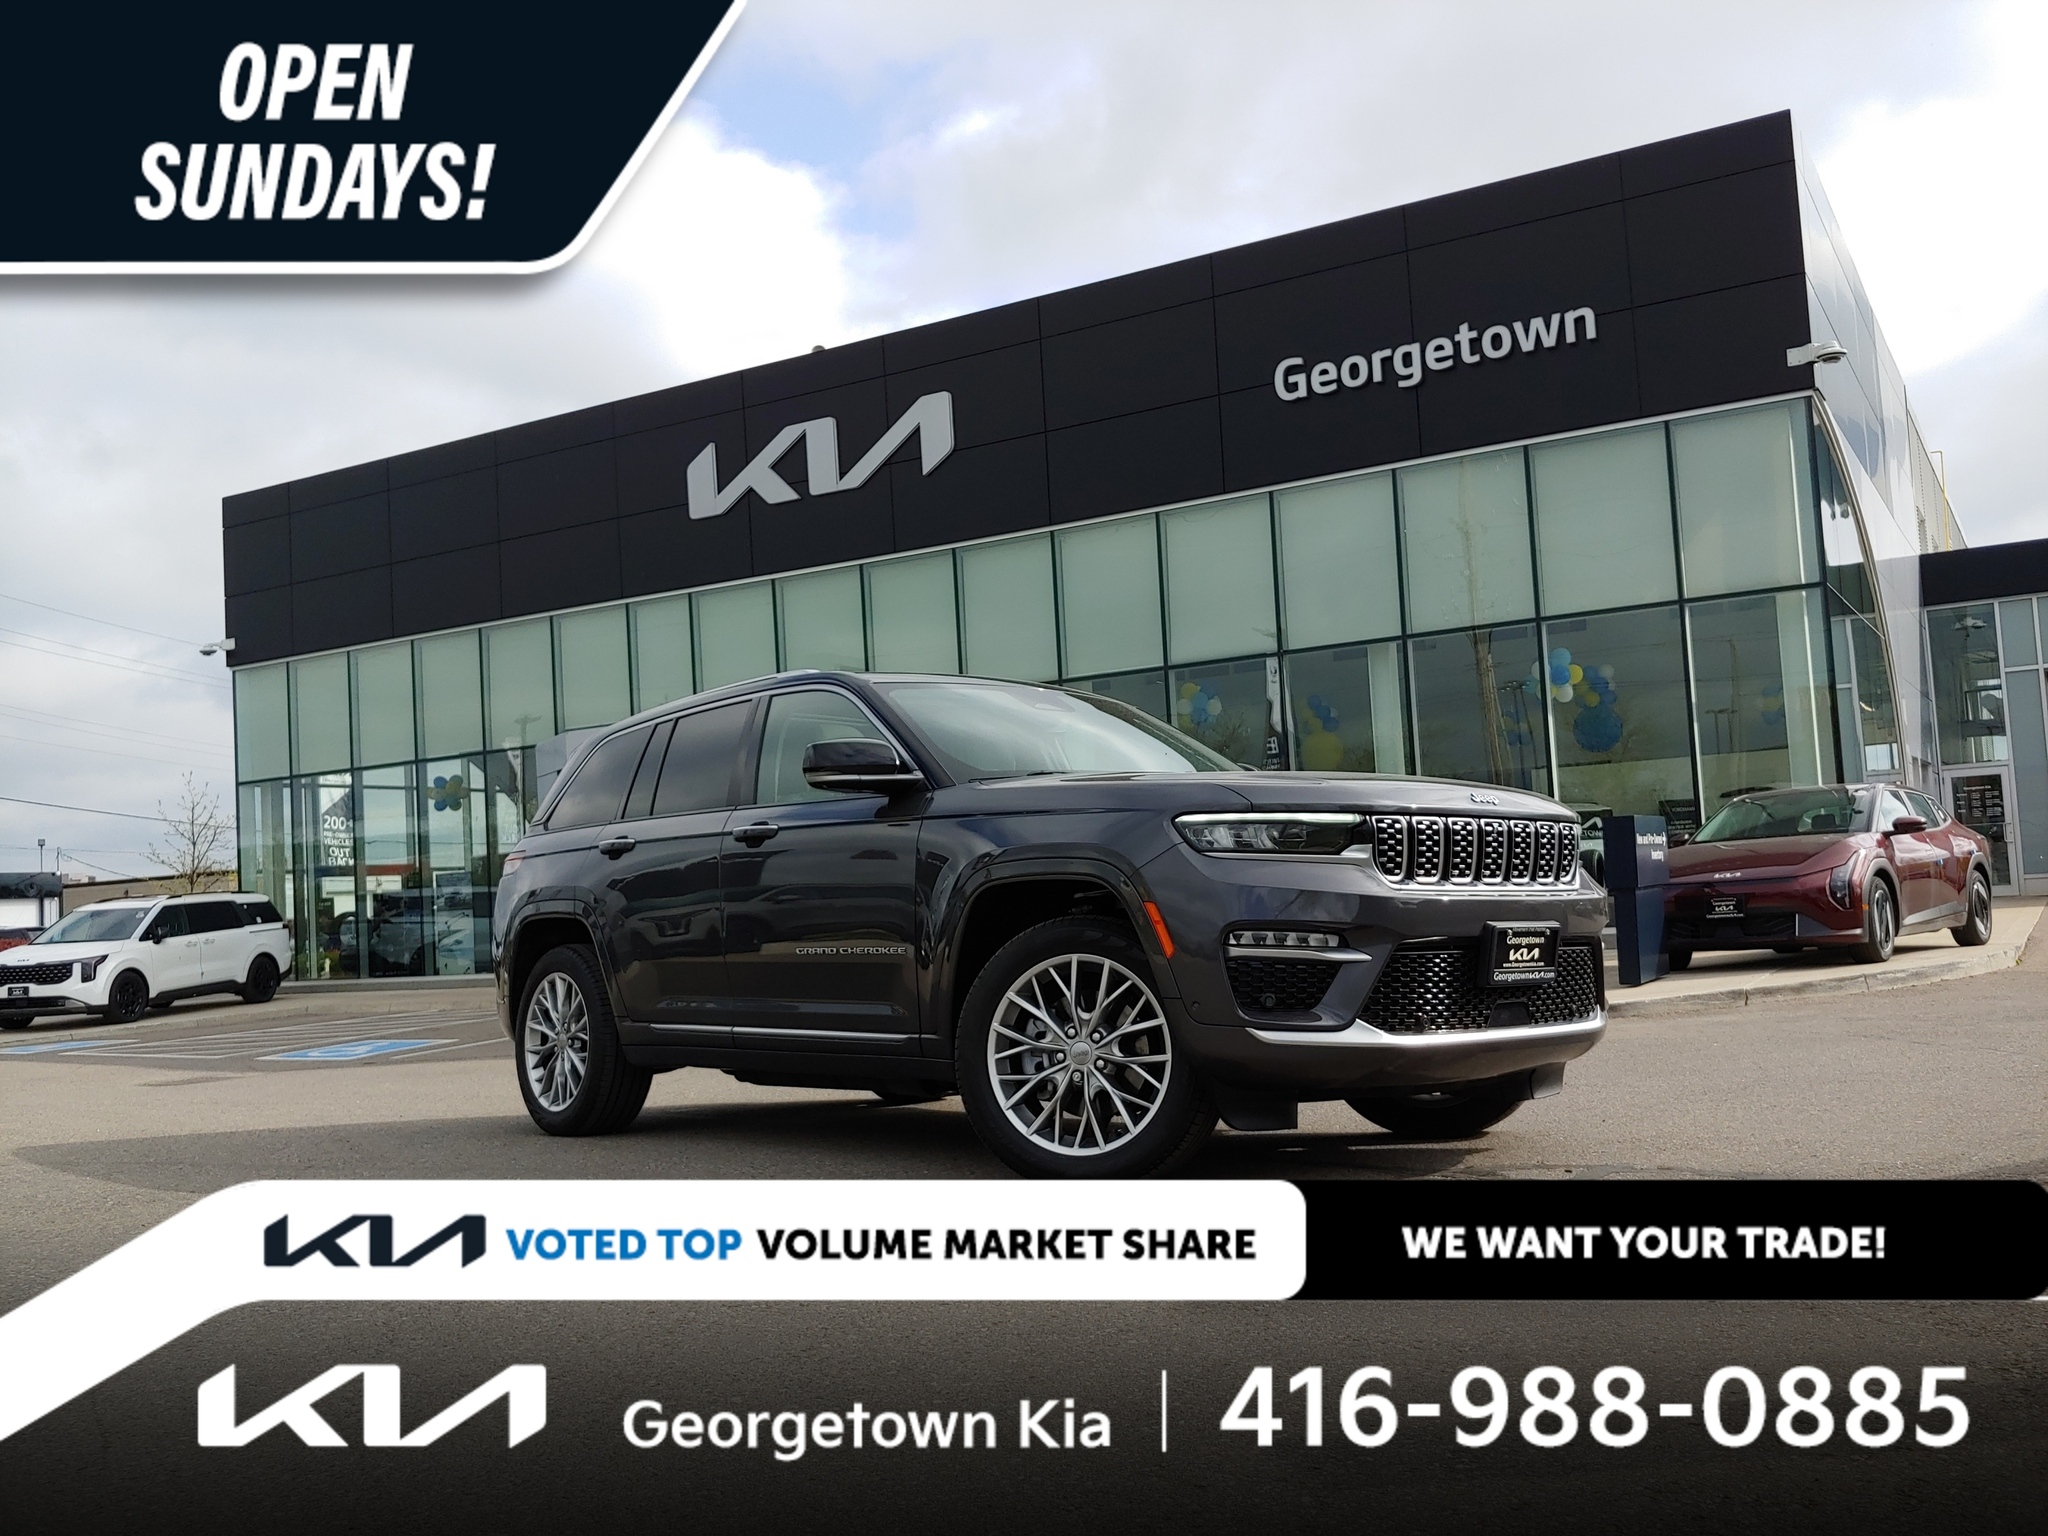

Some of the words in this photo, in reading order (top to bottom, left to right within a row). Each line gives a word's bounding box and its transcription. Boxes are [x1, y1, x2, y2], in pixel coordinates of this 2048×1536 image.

[1274, 306, 1597, 401] Georgetown
[687, 391, 954, 519] KIA
[1470, 793, 1500, 805] Jeep
[329, 847, 350, 857] OUT
[1507, 936, 1545, 946] Georgetown
[795, 947, 837, 955] GRAND
[839, 947, 906, 955] CHEROKEE
[1509, 947, 1540, 961] KIA
